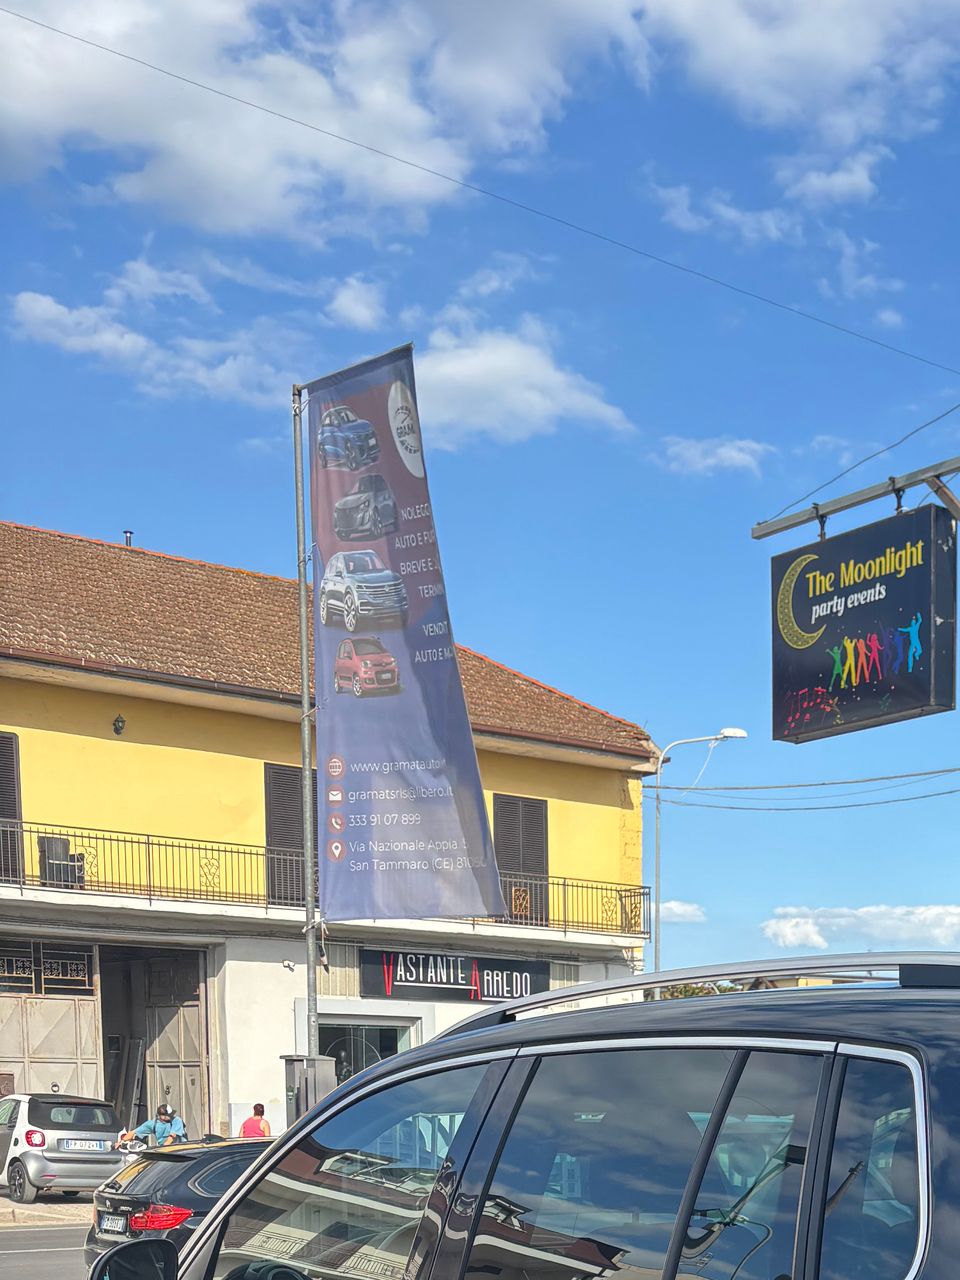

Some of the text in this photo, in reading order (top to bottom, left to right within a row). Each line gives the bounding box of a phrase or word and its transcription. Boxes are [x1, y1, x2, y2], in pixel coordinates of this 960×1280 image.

[395, 535, 417, 550] AUTO
[418, 533, 423, 545] E
[400, 559, 427, 575] BREVE
[427, 558, 433, 571] E
[806, 539, 925, 598] The Moonlight
[811, 582, 887, 624] party events
[423, 621, 448, 637] VENDIT
[415, 650, 437, 663] AUTO
[348, 813, 421, 827] 333 91 07 899
[349, 841, 366, 852] Via
[368, 840, 425, 852] Nazionale
[427, 839, 458, 851] Appia
[349, 860, 369, 872] San
[371, 859, 429, 871] Tammaro
[431, 858, 454, 872] (CE)
[383, 953, 532, 1001] VASTANTE ARREDO
